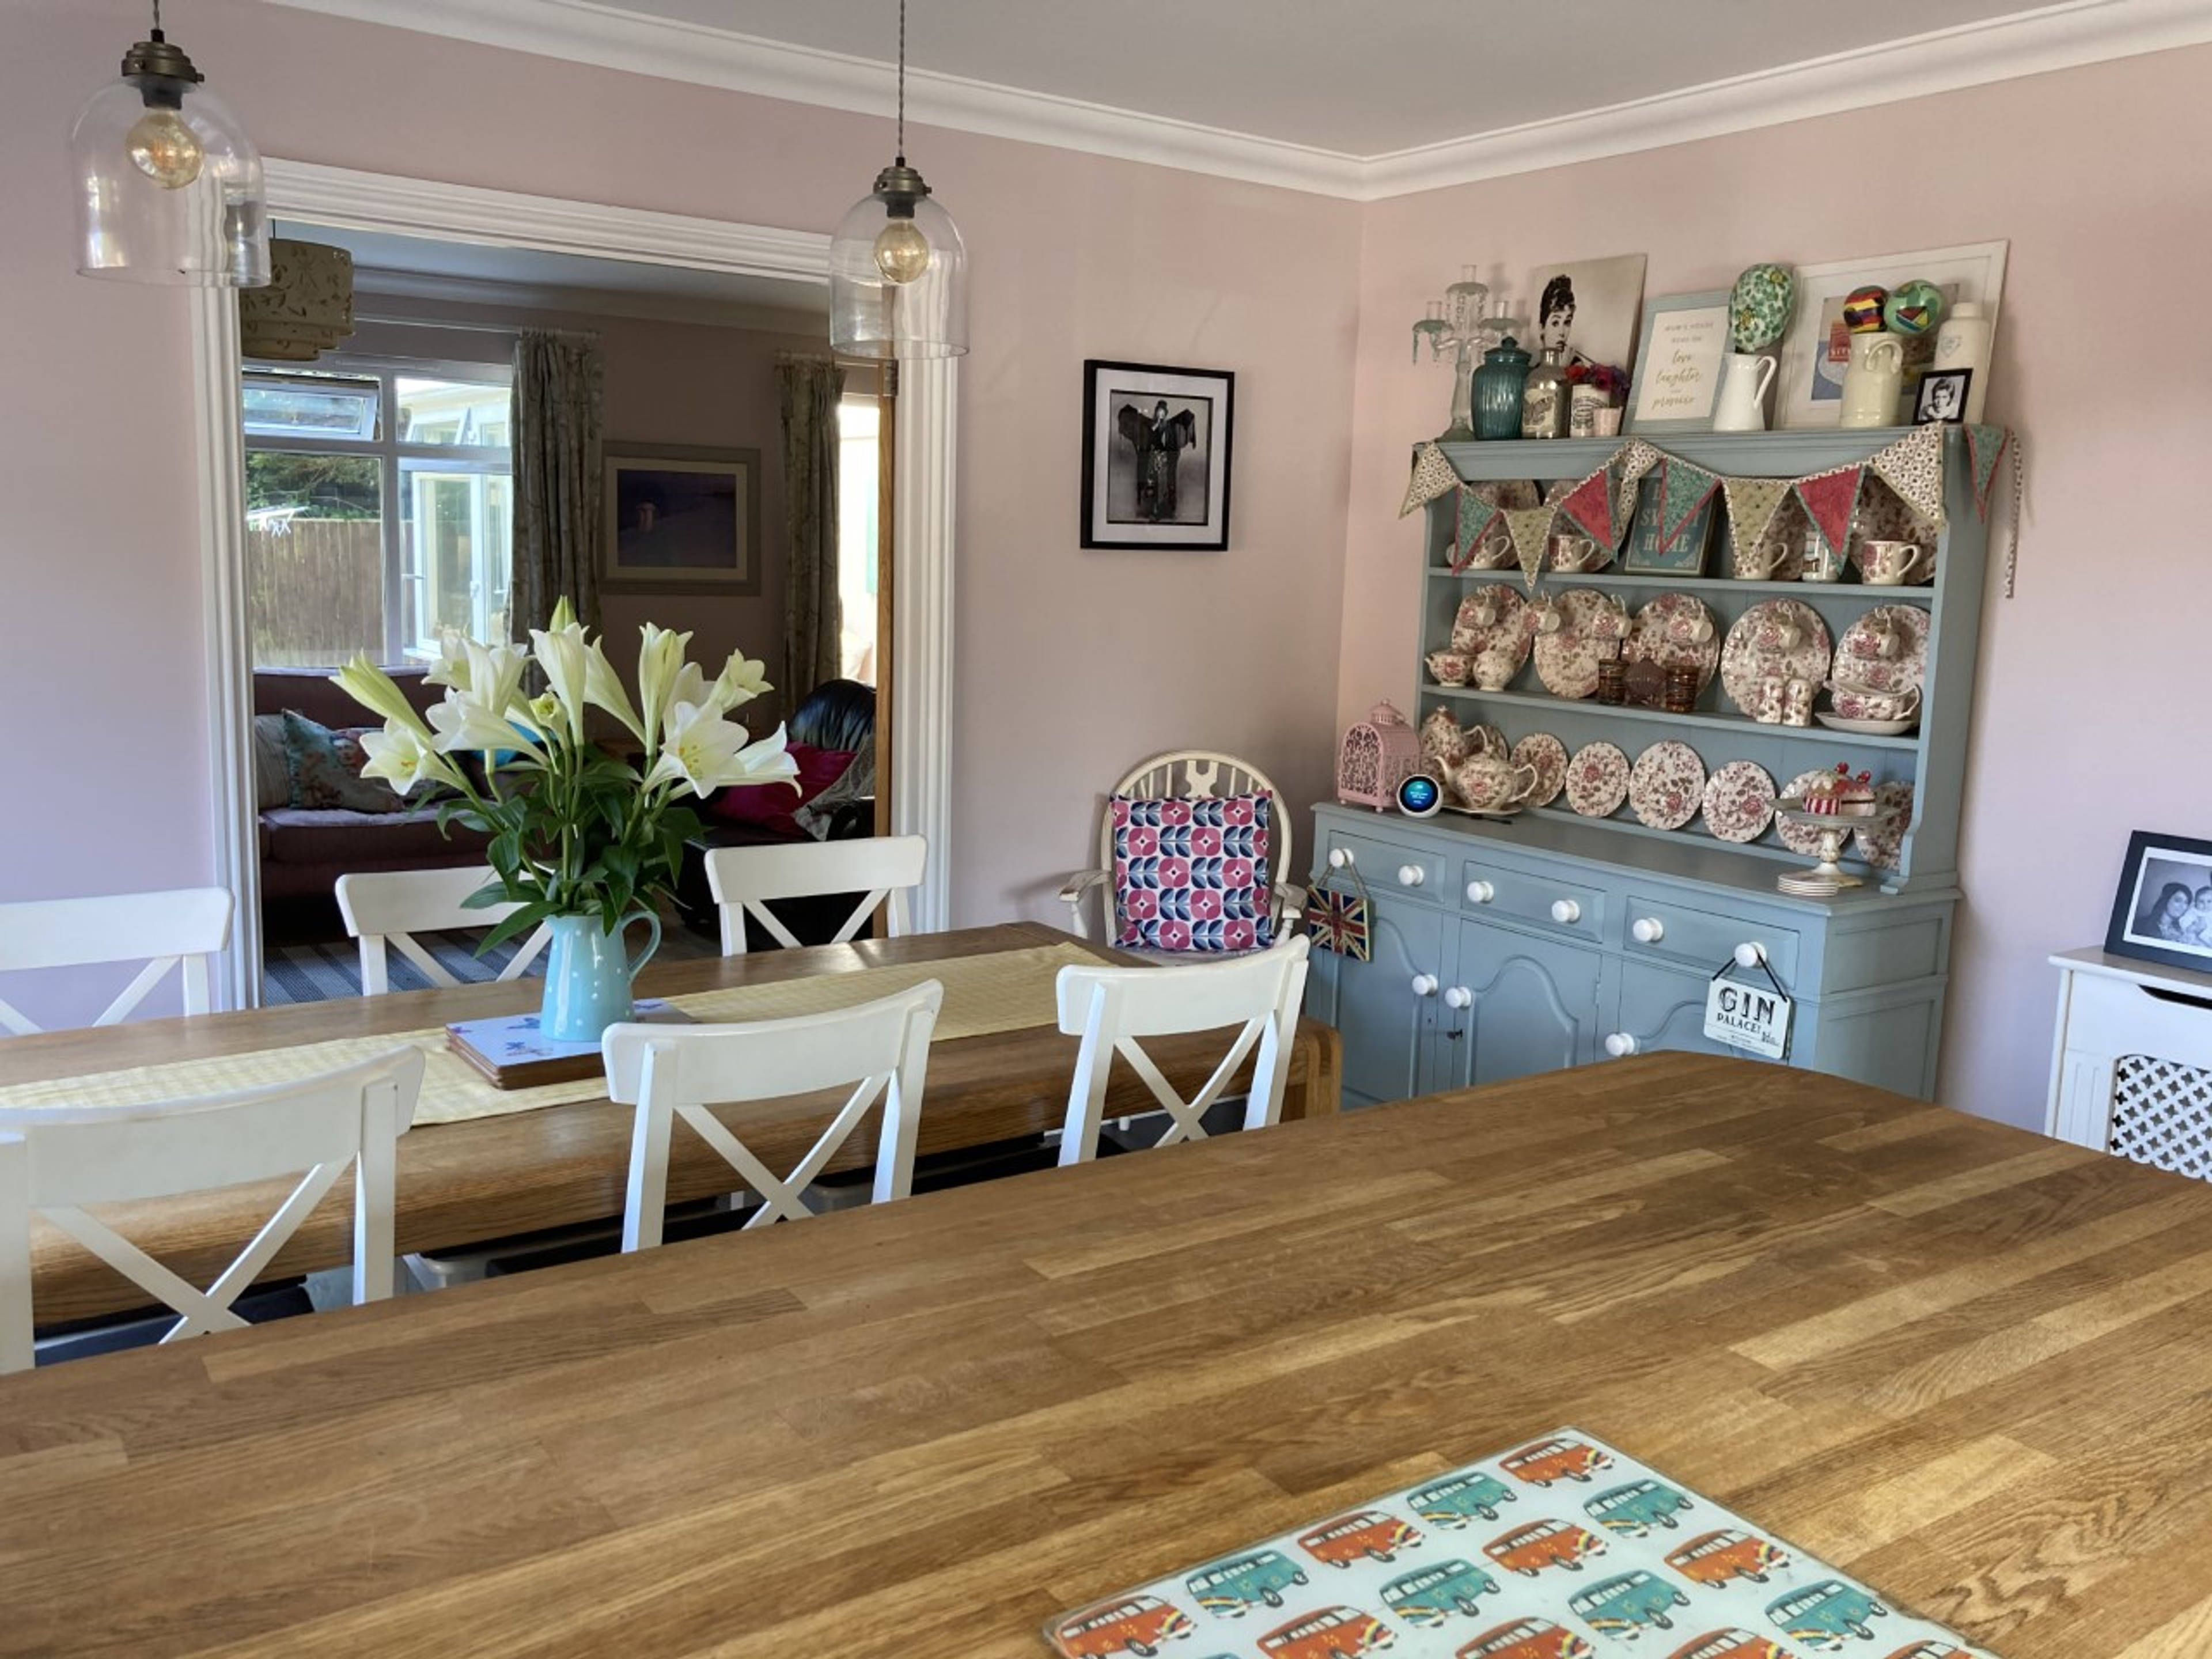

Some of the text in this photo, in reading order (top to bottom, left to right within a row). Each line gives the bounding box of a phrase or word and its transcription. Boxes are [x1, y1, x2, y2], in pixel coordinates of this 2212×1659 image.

[1672, 349, 1692, 365] love
[1656, 368, 1700, 387] laughter
[1719, 987, 1775, 1024] GIN
